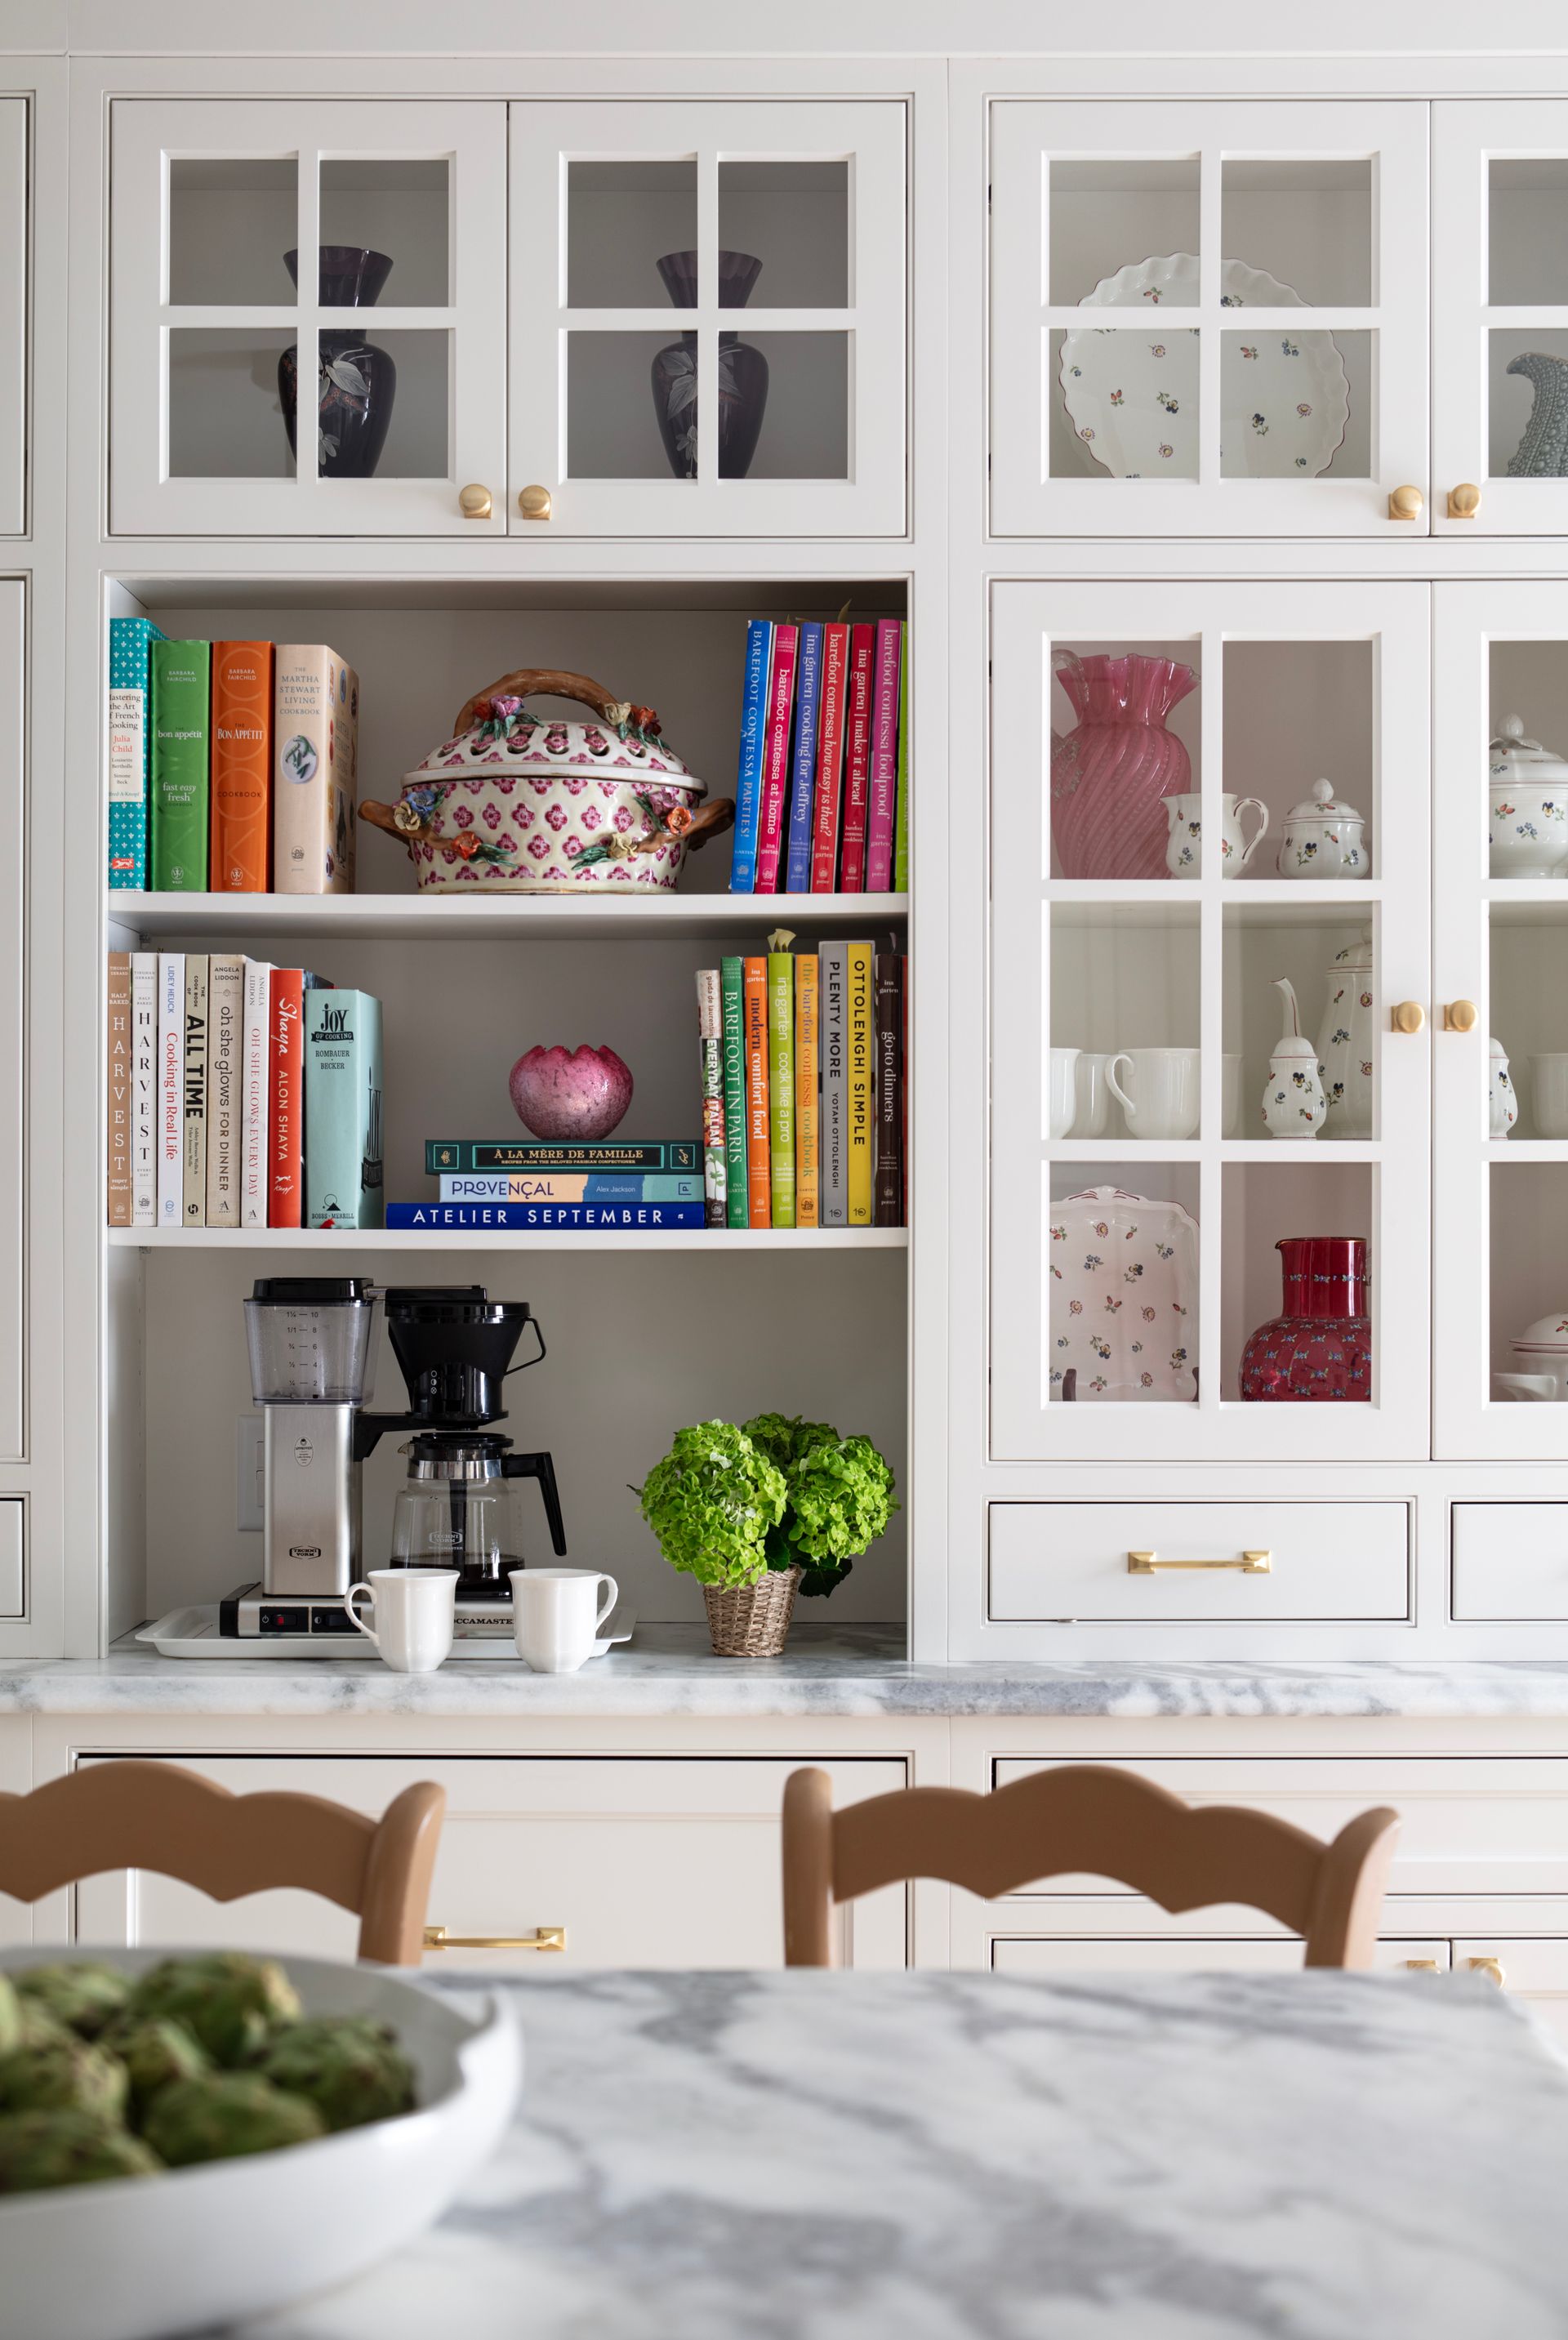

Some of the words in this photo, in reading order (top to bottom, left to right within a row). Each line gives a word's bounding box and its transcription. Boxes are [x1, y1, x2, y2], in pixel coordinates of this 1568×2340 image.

[807, 634, 817, 654] ina
[827, 634, 842, 684] barefoot
[859, 649, 871, 668] ina
[882, 629, 898, 687] barefoot
[750, 631, 762, 703] BAREFOOT
[803, 657, 816, 698] garten
[776, 669, 790, 721] barefoot
[853, 672, 866, 710] garten
[825, 687, 836, 738] contessa
[880, 691, 893, 749] contessa
[114, 735, 131, 743] Julia
[175, 730, 202, 740] appétit
[217, 729, 232, 739] BON
[234, 729, 264, 739] APPÉTIT
[744, 707, 758, 777] CONTESSA
[798, 706, 813, 758] cooking
[853, 720, 867, 753] make
[771, 724, 783, 780] contessa
[800, 760, 811, 778] for
[823, 740, 836, 765] how
[853, 757, 865, 765] it
[163, 782, 178, 791] fast
[180, 784, 196, 794] easy
[168, 793, 190, 801] fresh
[770, 784, 779, 796] at
[818, 767, 831, 794] easy
[822, 795, 833, 804] is
[852, 769, 865, 806] ahead
[875, 755, 893, 820] foolproof
[741, 782, 752, 837] PARTIES!
[767, 800, 780, 834] home
[794, 780, 809, 823] Jeffrey
[820, 805, 833, 837] that?
[777, 978, 789, 996] ina
[804, 964, 813, 984] the
[830, 962, 840, 1024] PLENTY
[186, 1014, 205, 1056] ALL
[220, 1006, 233, 1026] oh
[271, 998, 297, 1057] Shaya
[751, 998, 764, 1050] modern
[775, 999, 789, 1040] garten
[804, 989, 813, 1043] barefoot
[854, 961, 865, 1073] OTTOLENGHI
[220, 1030, 233, 1056] she
[252, 1029, 260, 1046] OH
[725, 992, 740, 1085] BAREFOOT
[830, 1032, 840, 1077] MORE
[882, 1032, 896, 1065] go-to
[164, 1032, 178, 1087] Cooking
[251, 1052, 260, 1076] SHE
[706, 1040, 719, 1099] EVERYDAY
[778, 1053, 791, 1083] cook
[804, 1049, 812, 1108] contessa
[114, 1018, 125, 1170] HARVEST
[139, 1013, 150, 1160] HARVEST
[167, 1091, 178, 1103] in
[185, 1063, 204, 1118] TIME
[214, 1060, 233, 1106] glows
[278, 1071, 288, 1108] ALON
[751, 1054, 765, 1104] comfort
[779, 1086, 791, 1107] like
[884, 1068, 896, 1122] dinners
[249, 1081, 260, 1125] GLOWS
[728, 1090, 741, 1109] IN
[854, 1083, 865, 1145] SIMPLE
[166, 1107, 178, 1133] Real
[220, 1112, 229, 1137] FOR
[278, 1116, 288, 1161] SHAYA
[708, 1101, 719, 1146] ITALIAN
[753, 1111, 766, 1139] food
[777, 1121, 790, 1143] pro
[166, 1137, 178, 1161] Life
[248, 1130, 259, 1168] EVERY
[494, 1148, 503, 1159] À
[507, 1151, 524, 1159] LA
[529, 1148, 564, 1159] MÈRE
[568, 1150, 585, 1158] DE
[590, 1150, 644, 1158] FAMILLE
[728, 1116, 742, 1163] PARIS
[804, 1112, 813, 1177] cookbook
[219, 1142, 229, 1191] DINNER
[248, 1174, 258, 1197] DAY
[452, 1181, 555, 1200] PROVENÇAL
[412, 1210, 507, 1223] ATELIER
[528, 1210, 662, 1223] SEPTEMBER
